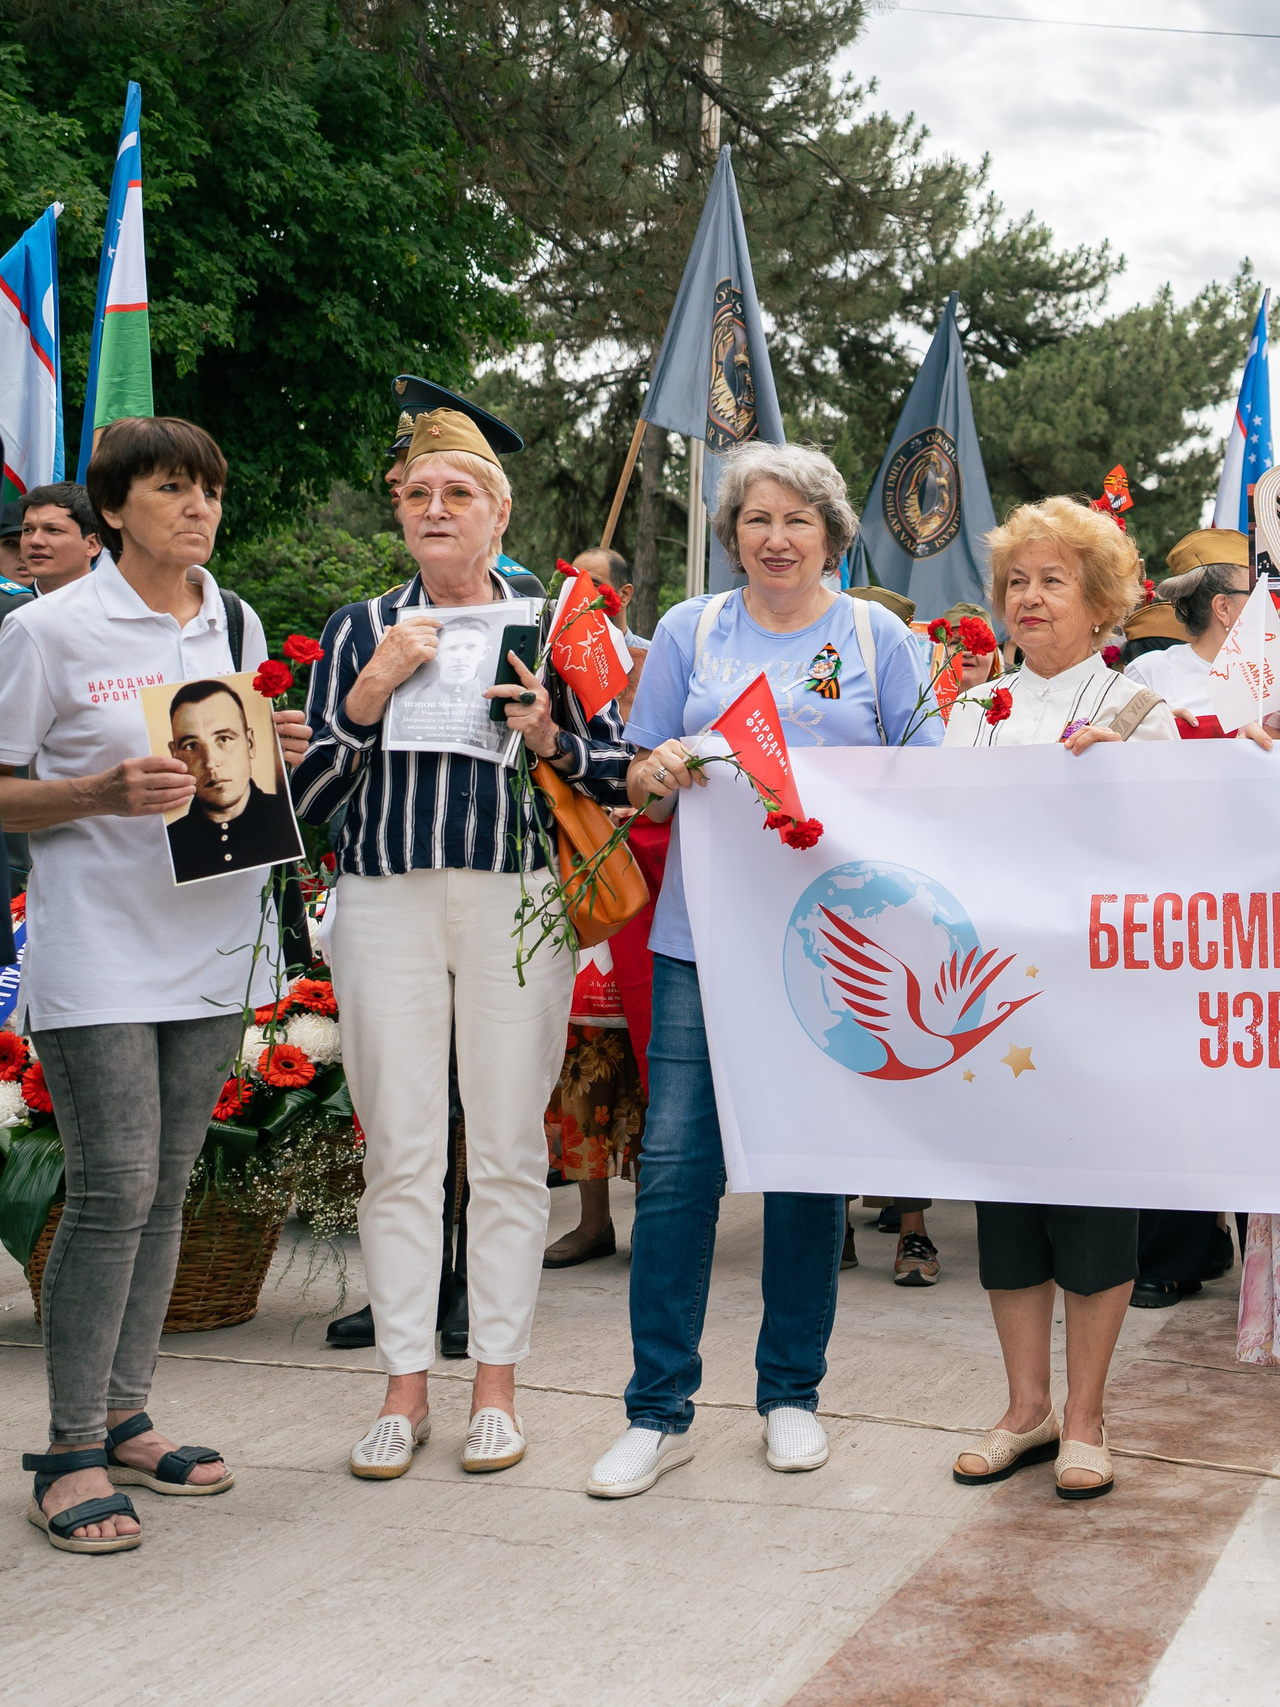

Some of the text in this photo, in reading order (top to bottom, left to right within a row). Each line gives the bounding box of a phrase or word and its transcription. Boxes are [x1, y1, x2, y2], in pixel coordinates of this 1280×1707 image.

[887, 454, 907, 488] ICHKI
[886, 491, 902, 533] ISHLAR
[88, 671, 165, 693] НАРОДНЫЙ
[91, 689, 138, 704] ФРОНТ
[745, 717, 774, 757] ФРОНТ
